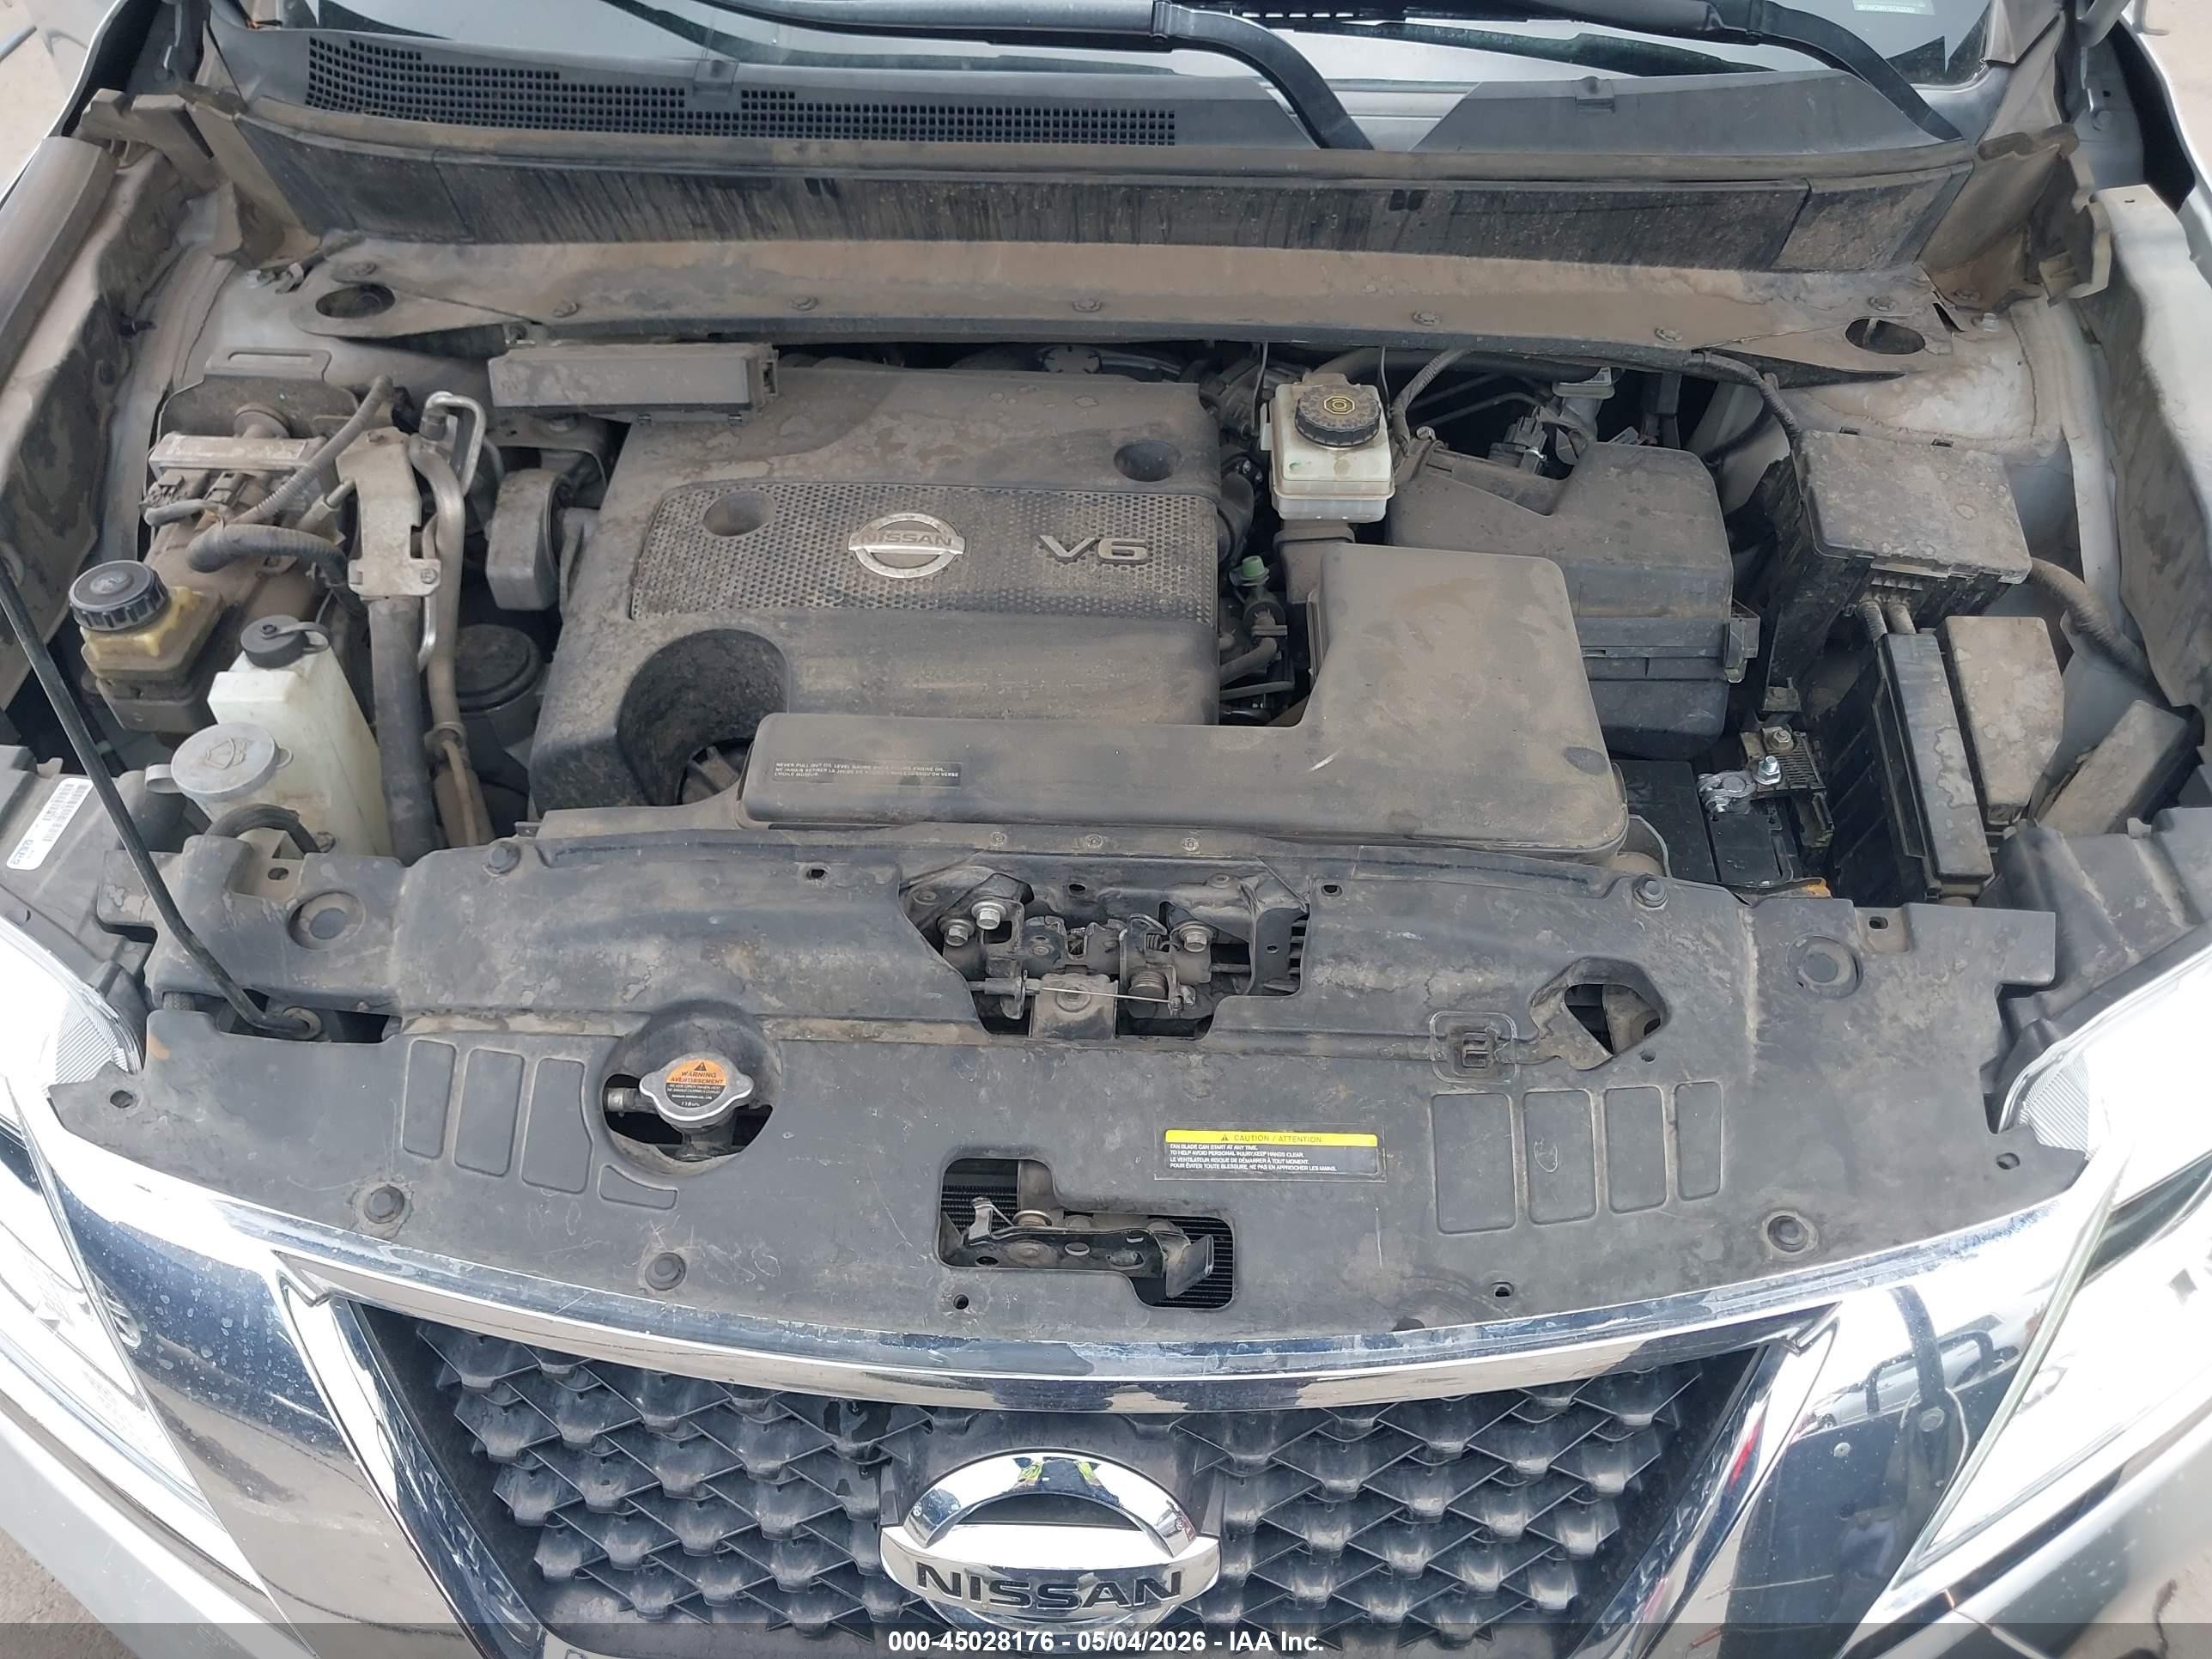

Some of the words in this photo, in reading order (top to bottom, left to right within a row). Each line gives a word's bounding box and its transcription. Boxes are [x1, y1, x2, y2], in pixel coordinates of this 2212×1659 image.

[860, 532, 952, 547] NISSAN
[1038, 534, 1151, 564] V6
[915, 1560, 1183, 1610] NISSAN
